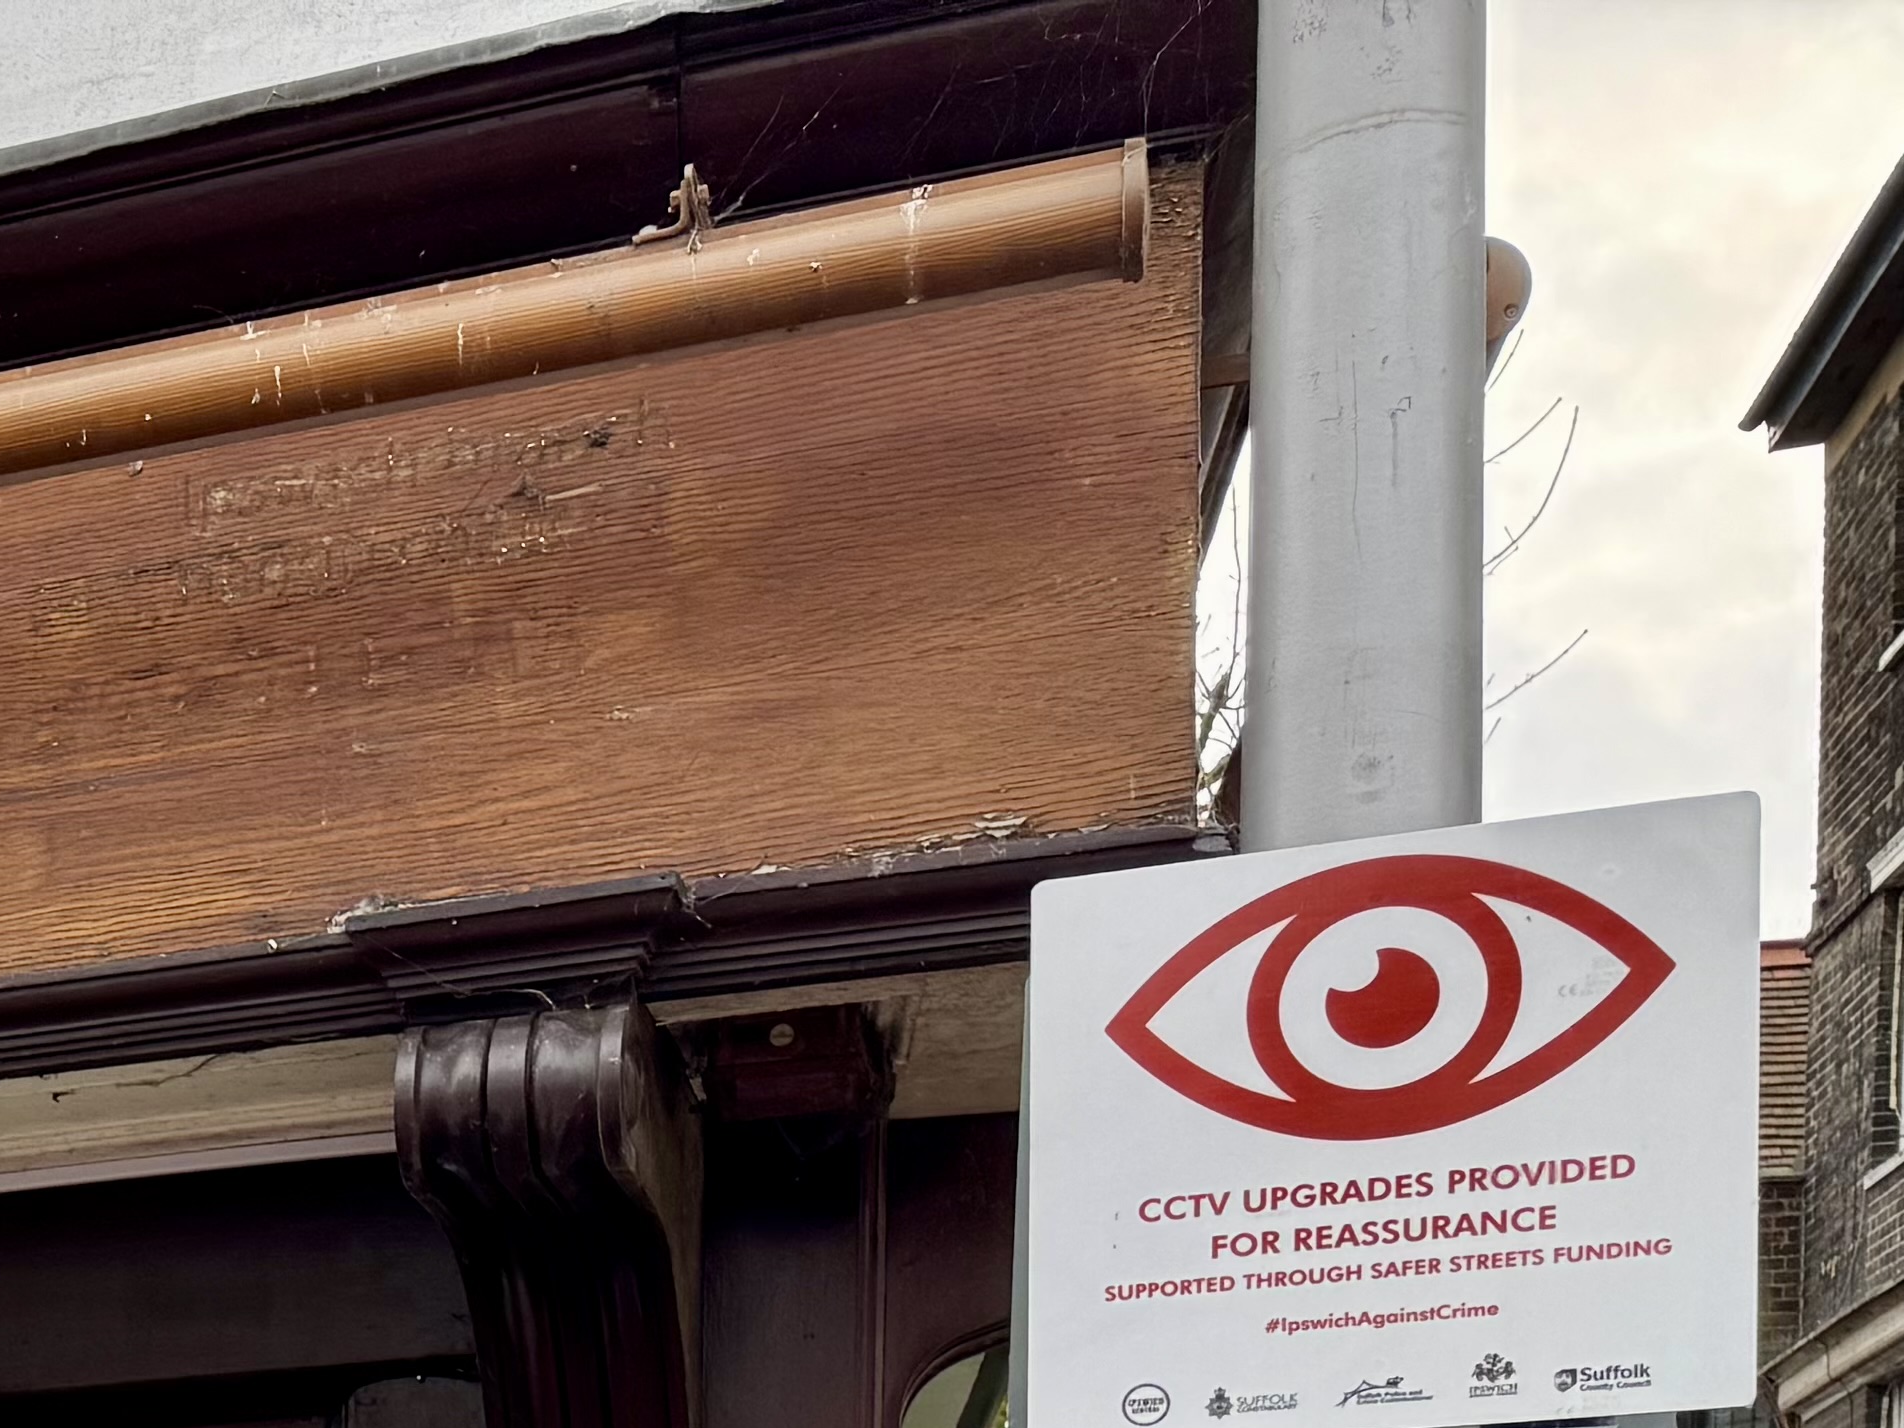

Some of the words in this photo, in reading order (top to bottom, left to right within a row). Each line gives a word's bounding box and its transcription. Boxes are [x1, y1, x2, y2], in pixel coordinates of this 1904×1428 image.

[1138, 1191, 1231, 1222] CCTV
[1243, 1172, 1434, 1214] UPGRADES
[1448, 1154, 1636, 1194] PROVIDED
[1211, 1231, 1280, 1259] FOR
[1294, 1205, 1557, 1252] REASSURANCE
[1104, 1275, 1236, 1302] SUPPORTED
[1243, 1264, 1362, 1290] THROUGH
[1371, 1258, 1441, 1279] SAFER
[1449, 1249, 1545, 1273] STREETS
[1553, 1238, 1672, 1263] FUNDING
[1265, 1302, 1499, 1335] #IpswichAgainstCrime
[1580, 1363, 1651, 1382] Suffolk
[1237, 1393, 1299, 1406] SUFFOLK
